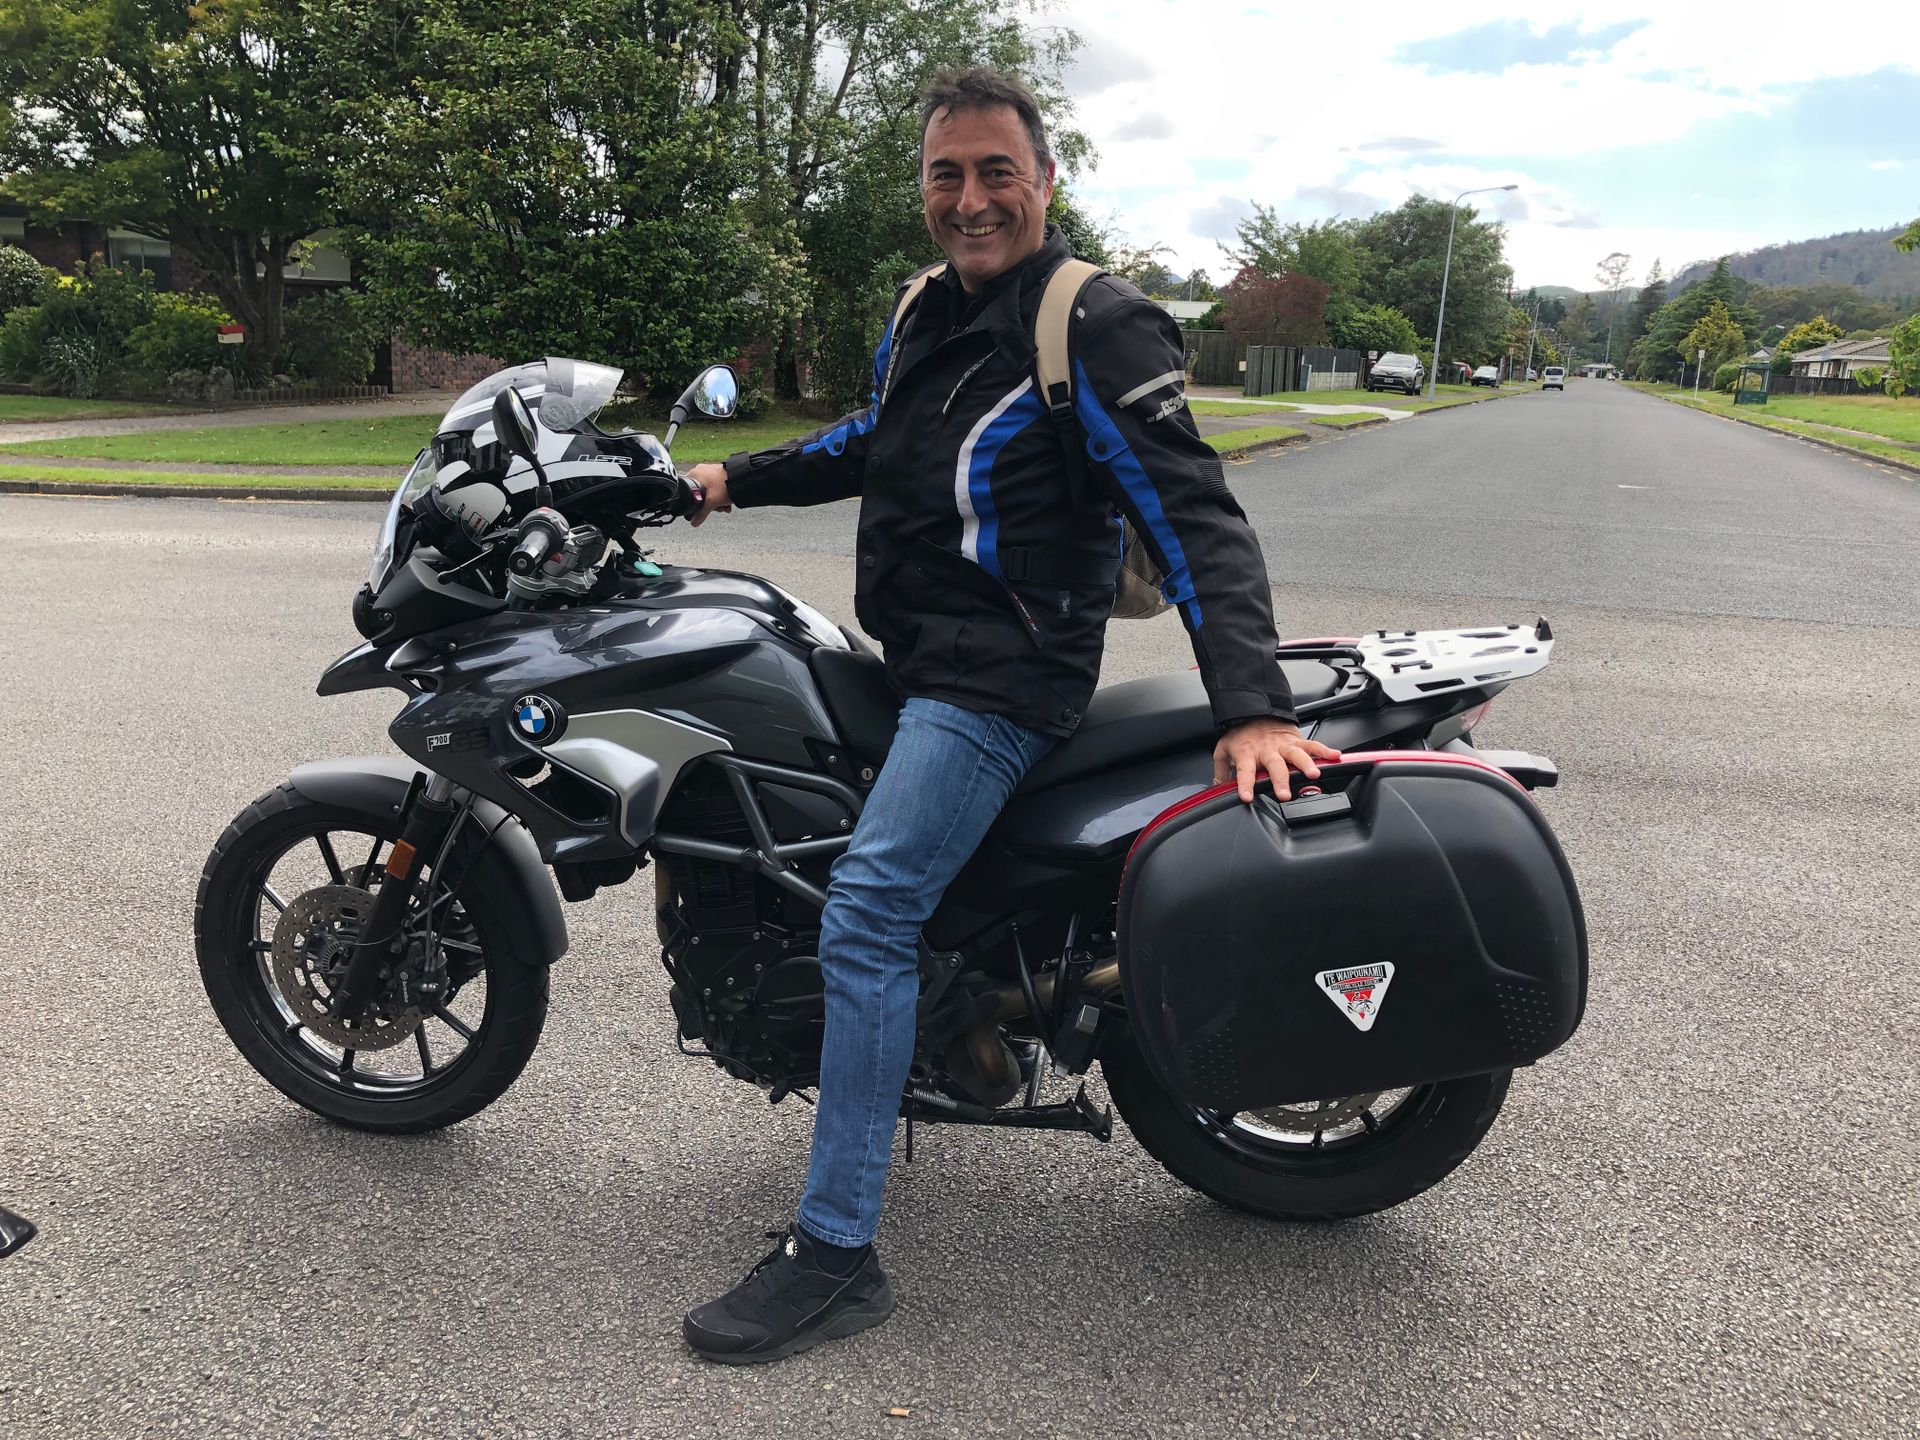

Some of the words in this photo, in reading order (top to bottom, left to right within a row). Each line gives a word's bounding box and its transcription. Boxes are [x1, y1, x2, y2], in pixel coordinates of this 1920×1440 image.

[513, 697, 549, 713] BMW
[1325, 973, 1336, 986] TE
[1336, 965, 1384, 981] WAIPOUNAMU
